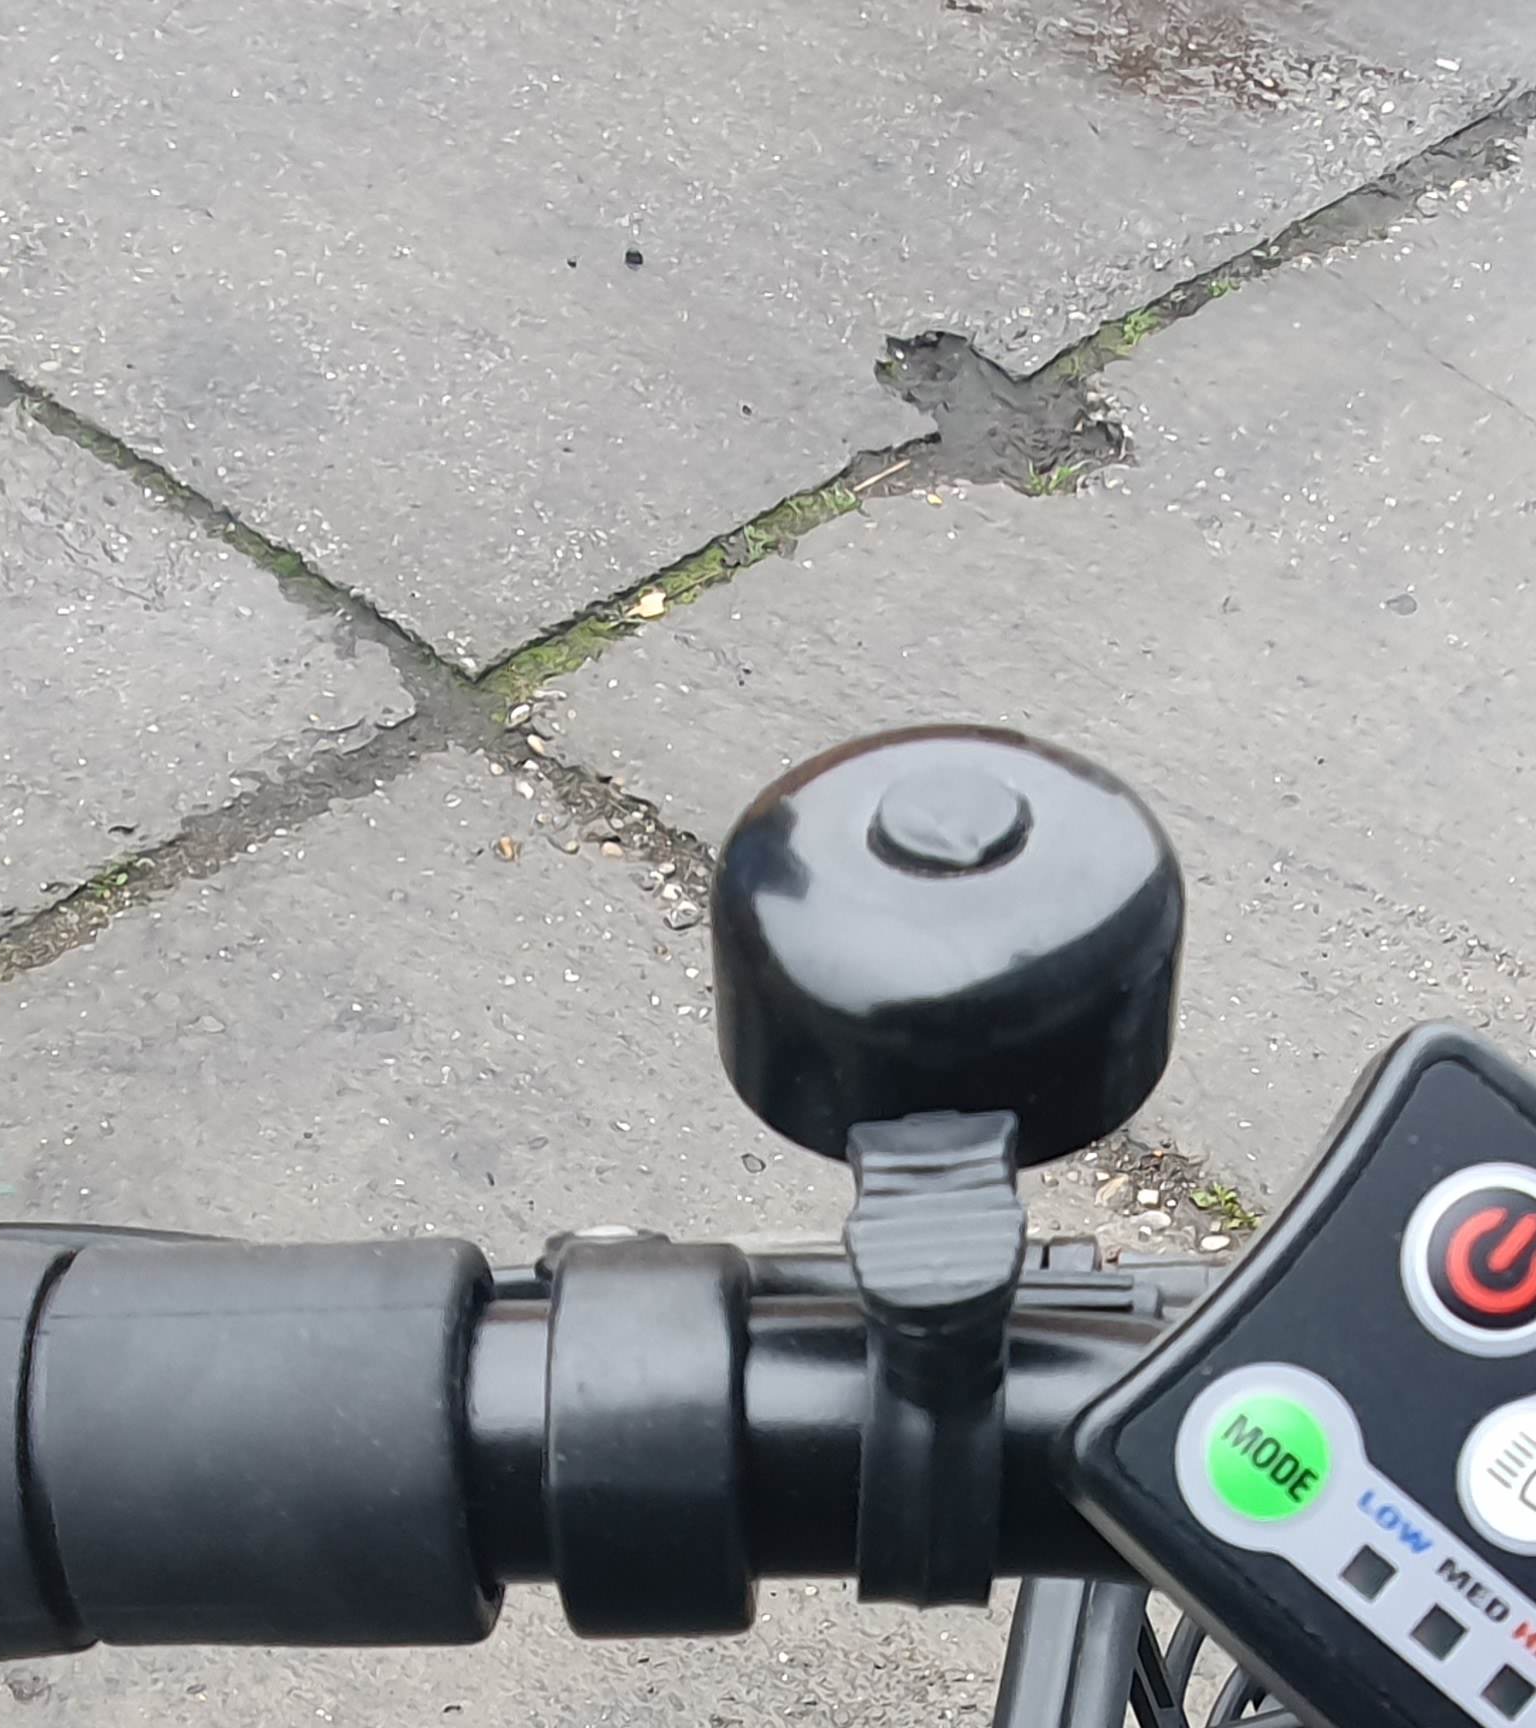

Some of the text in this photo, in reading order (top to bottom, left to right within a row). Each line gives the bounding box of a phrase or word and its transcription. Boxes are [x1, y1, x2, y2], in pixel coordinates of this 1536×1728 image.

[1221, 1413, 1319, 1503] MODE
[1358, 1489, 1434, 1554] LOW
[1435, 1556, 1511, 1623] MED
